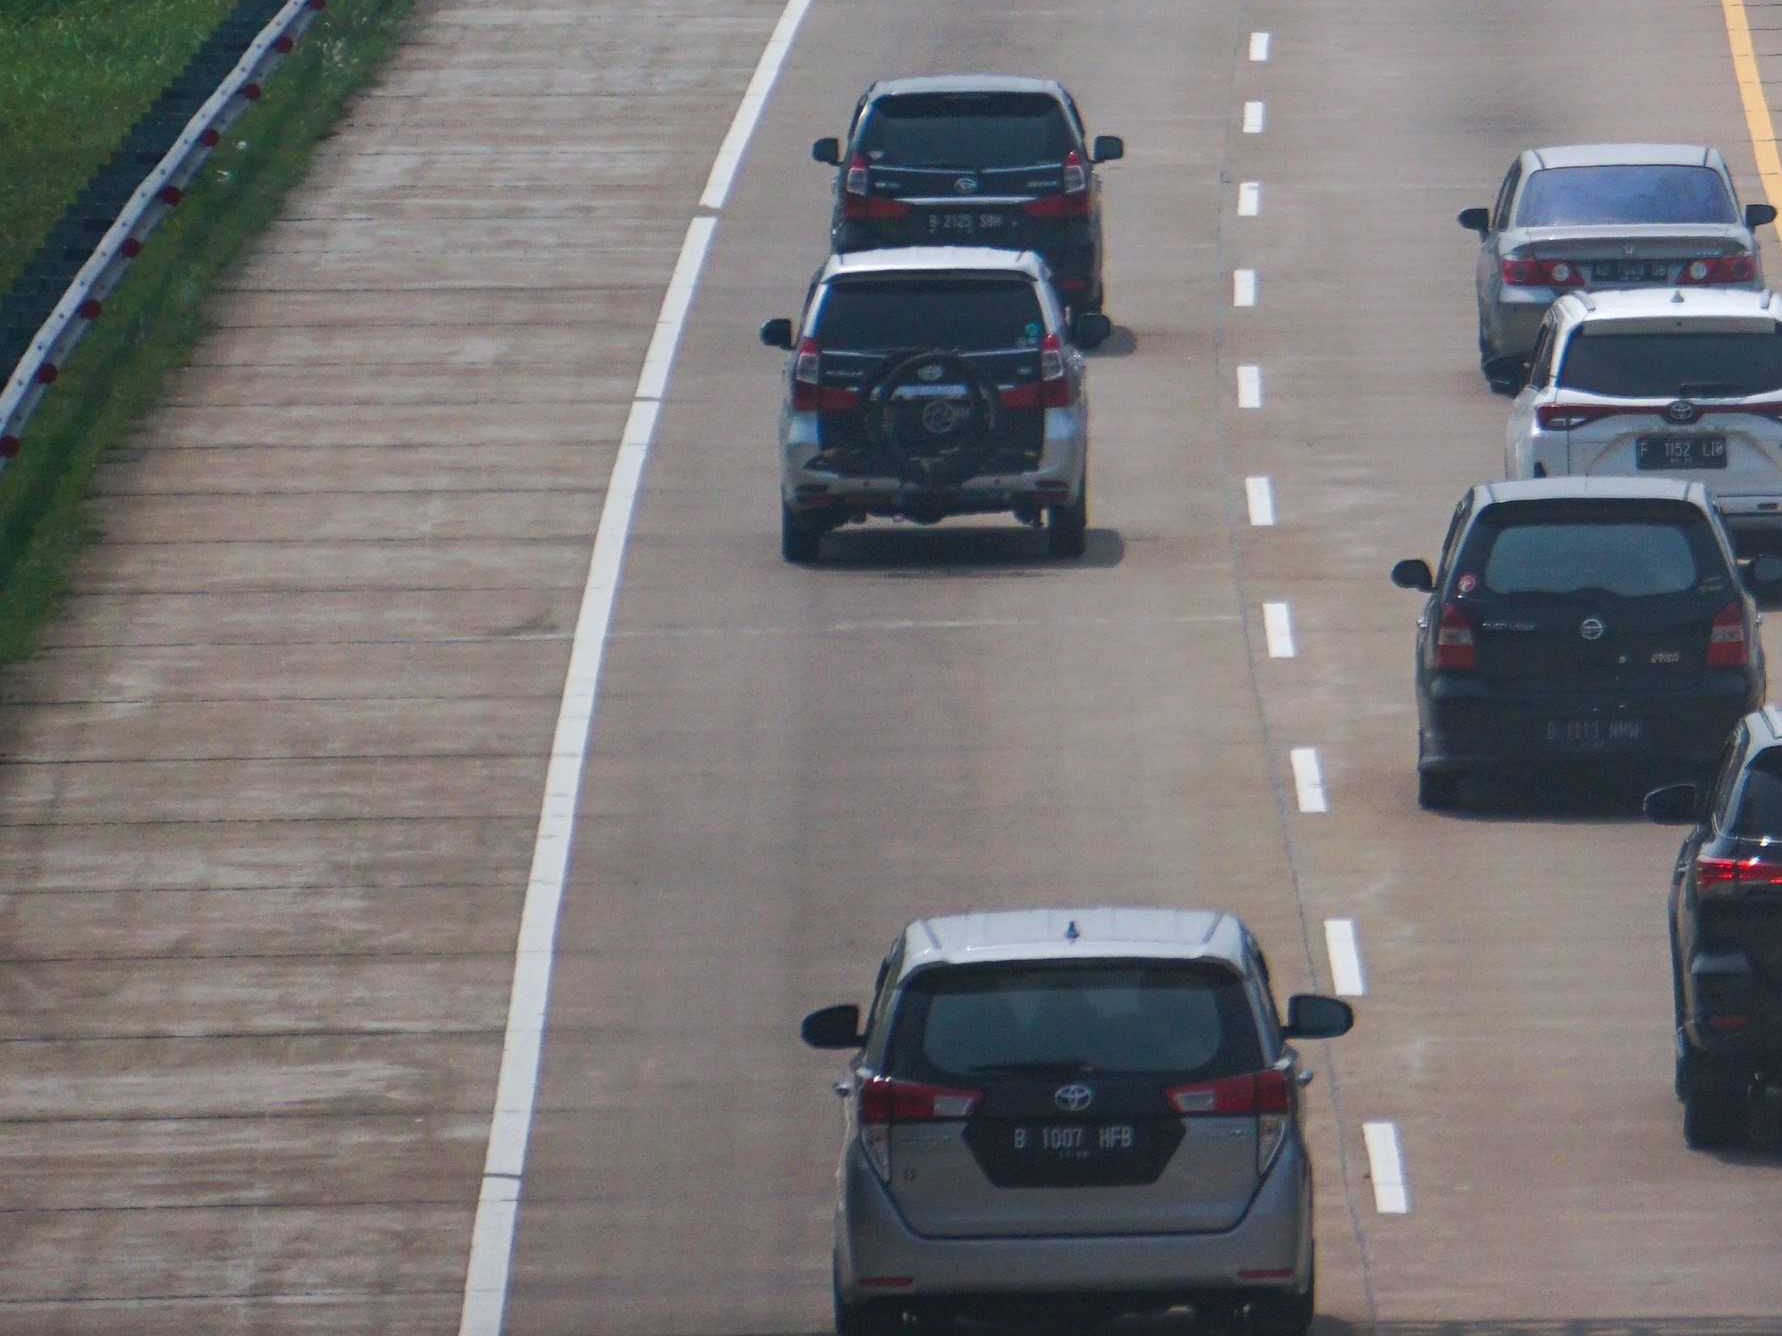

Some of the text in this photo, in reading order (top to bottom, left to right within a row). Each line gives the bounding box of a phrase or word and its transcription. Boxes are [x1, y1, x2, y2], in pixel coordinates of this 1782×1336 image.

[1641, 442, 1648, 457] F
[1665, 442, 1690, 457] 1152
[1015, 1128, 1026, 1149] B
[1042, 1127, 1084, 1149] 1007
